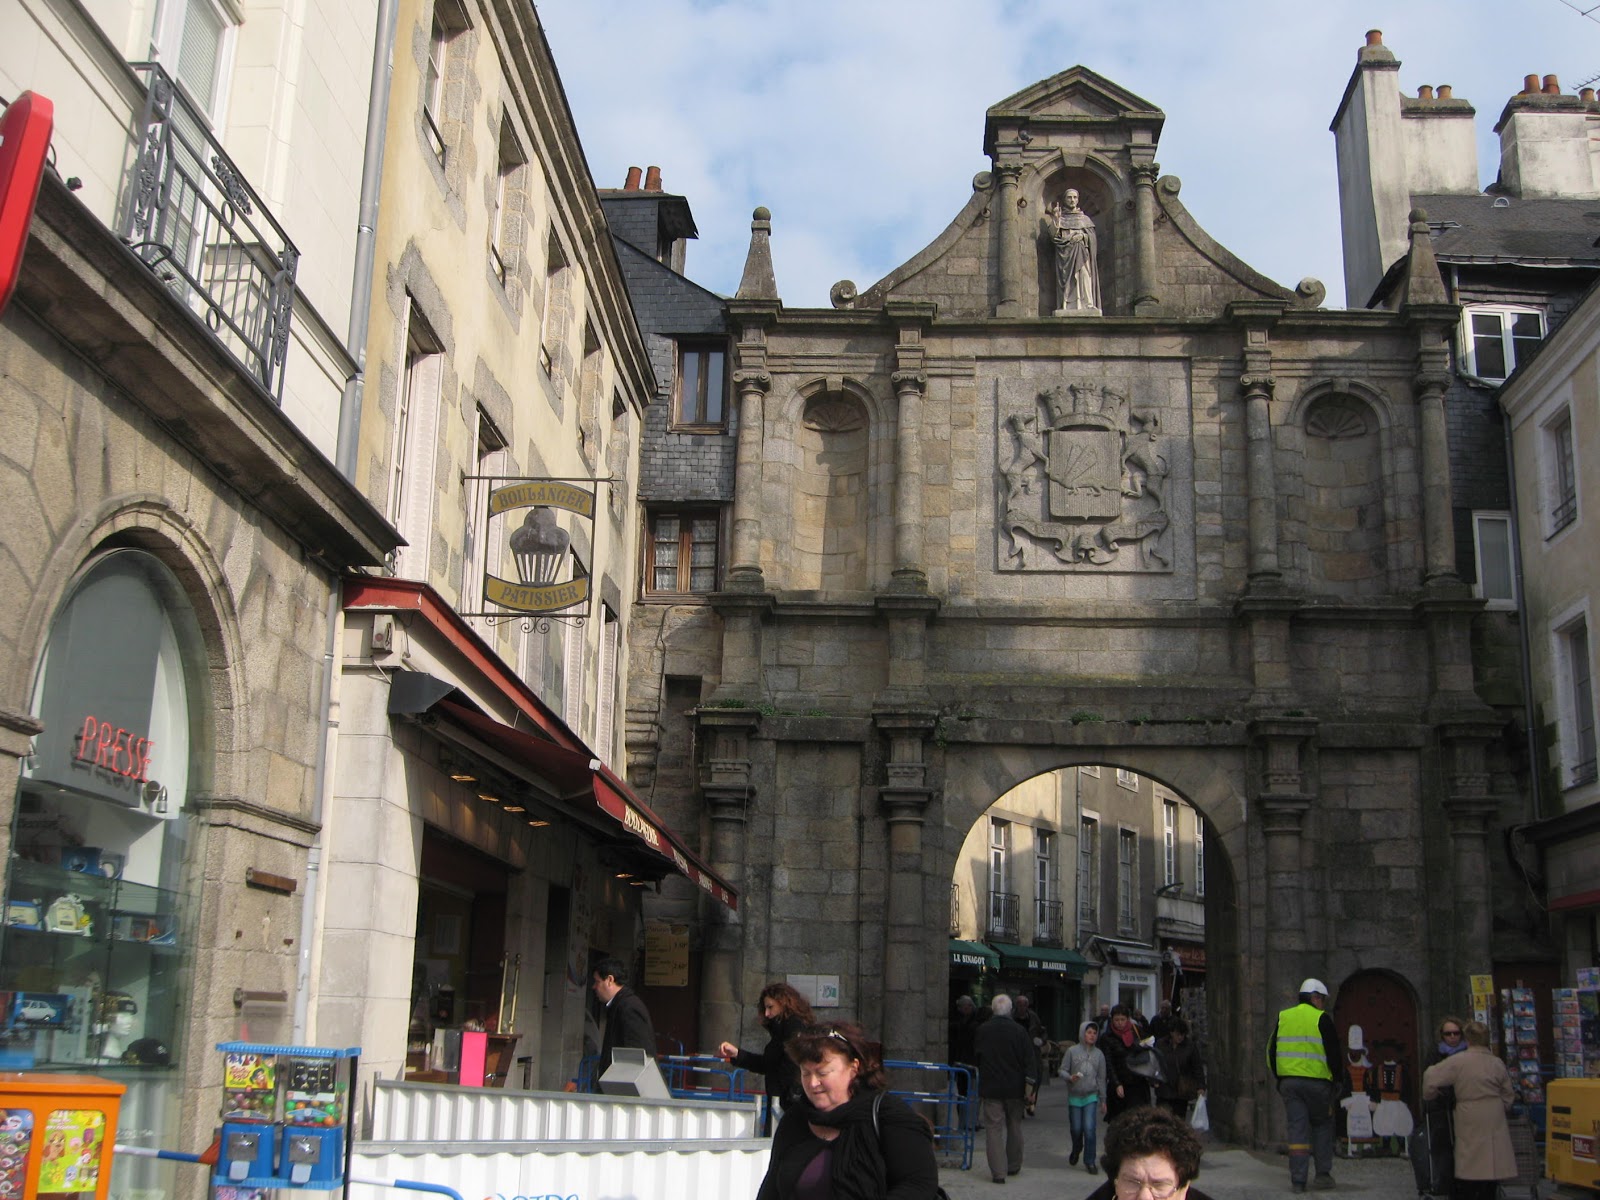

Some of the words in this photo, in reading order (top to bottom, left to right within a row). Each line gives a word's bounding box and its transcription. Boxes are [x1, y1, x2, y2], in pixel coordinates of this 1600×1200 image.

[499, 486, 586, 509] BOULANGER
[500, 585, 579, 607] PATISSIER
[78, 715, 155, 783] PRESSE
[953, 953, 962, 963] LE
[962, 954, 986, 966] SINAGOT
[1028, 959, 1039, 969] BAR
